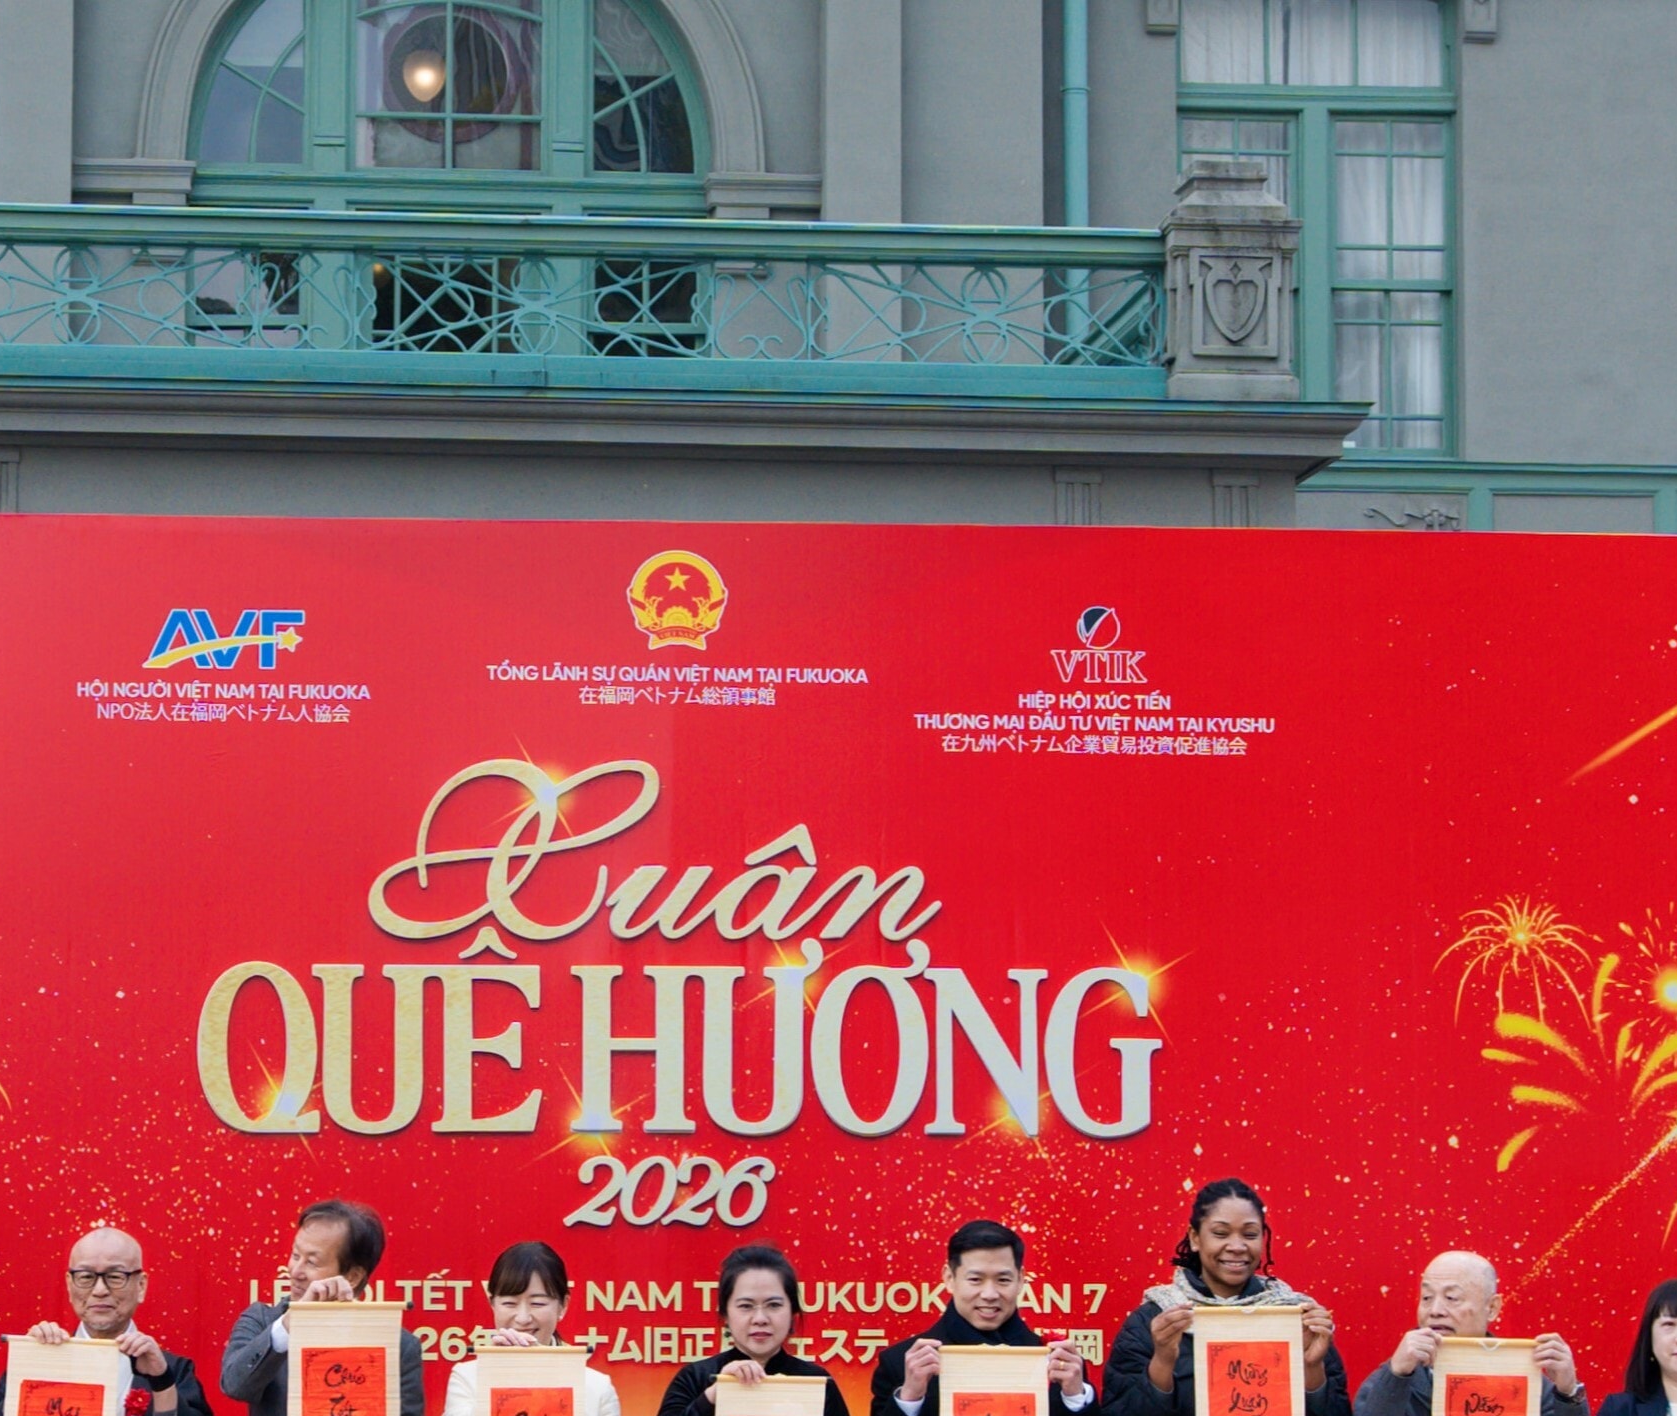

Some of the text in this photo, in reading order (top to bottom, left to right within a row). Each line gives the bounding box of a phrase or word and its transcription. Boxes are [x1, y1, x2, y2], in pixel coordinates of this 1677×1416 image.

[143, 608, 306, 670] AVF
[619, 663, 670, 683] QUÁN
[674, 663, 710, 687] VIỆT
[714, 667, 753, 683] NAM
[757, 667, 782, 688] TẠI
[786, 668, 868, 684] FUKUOKA
[1051, 649, 1147, 683] VTIK
[76, 679, 371, 703] HỘI NGƯỜI VIỆT NAM TẠI FUKUOKA
[578, 685, 776, 706] 在福岡ベトナム総領事館
[1018, 690, 1171, 714] HIỆP HỘI XÚC TIẾN
[96, 702, 351, 723] NPO法人在福岡ベトナム人協会
[914, 712, 990, 730] THƯƠNG
[993, 715, 1024, 734] MẠI
[1069, 714, 1093, 731] TƯ
[1096, 713, 1130, 736] VIỆT
[1135, 717, 1173, 732] NAM
[1177, 717, 1203, 737] TẠI
[1206, 717, 1275, 734] KYUSHU
[367, 757, 941, 942] Xuân
[197, 926, 1164, 1140] QUÊ HƯƠNG
[563, 1153, 777, 1230] 2026
[395, 1268, 473, 1311] TẾT
[585, 1279, 683, 1311] NAM
[798, 1281, 950, 1314] UKUOK
[1083, 1283, 1109, 1314] 7
